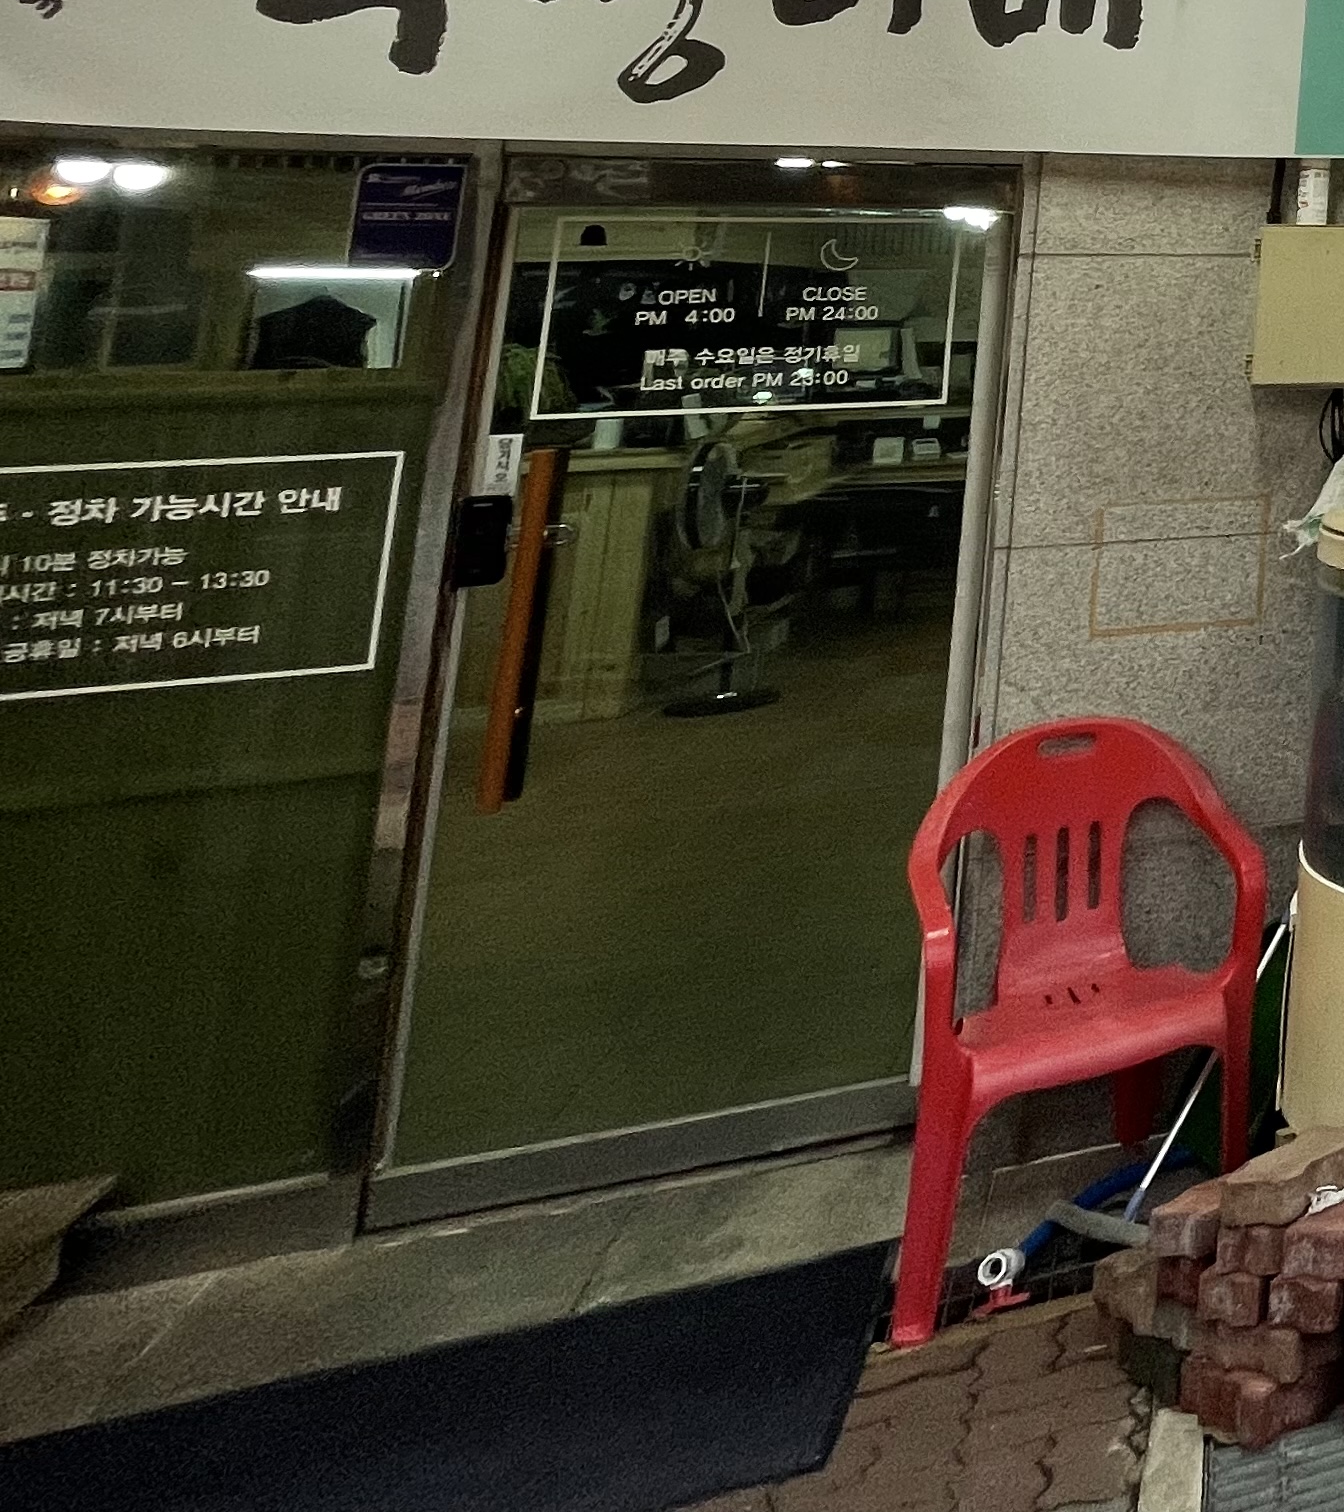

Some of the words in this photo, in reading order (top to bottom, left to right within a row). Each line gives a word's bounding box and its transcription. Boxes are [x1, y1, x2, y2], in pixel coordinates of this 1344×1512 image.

[658, 288, 717, 305] OPEN
[802, 287, 867, 301] CLOSE
[635, 310, 668, 325] PM
[685, 308, 735, 323] 4:00
[786, 306, 816, 321] PM
[822, 306, 878, 320] 24:00
[694, 347, 775, 365] 수요일은
[784, 345, 861, 364] 정기휴일
[640, 376, 683, 391] Last
[690, 374, 746, 389] order
[752, 372, 782, 388] PM
[48, 498, 118, 526] 정차
[131, 491, 266, 522] 가능시간
[277, 487, 343, 515] 안내
[87, 546, 189, 570] 정차가능
[91, 576, 164, 598] 11:30
[200, 569, 271, 590] 13:30
[31, 608, 85, 630] 저녁
[95, 601, 184, 626] 7시부터
[112, 632, 163, 653] 저녁
[173, 625, 262, 648] 6시부터
